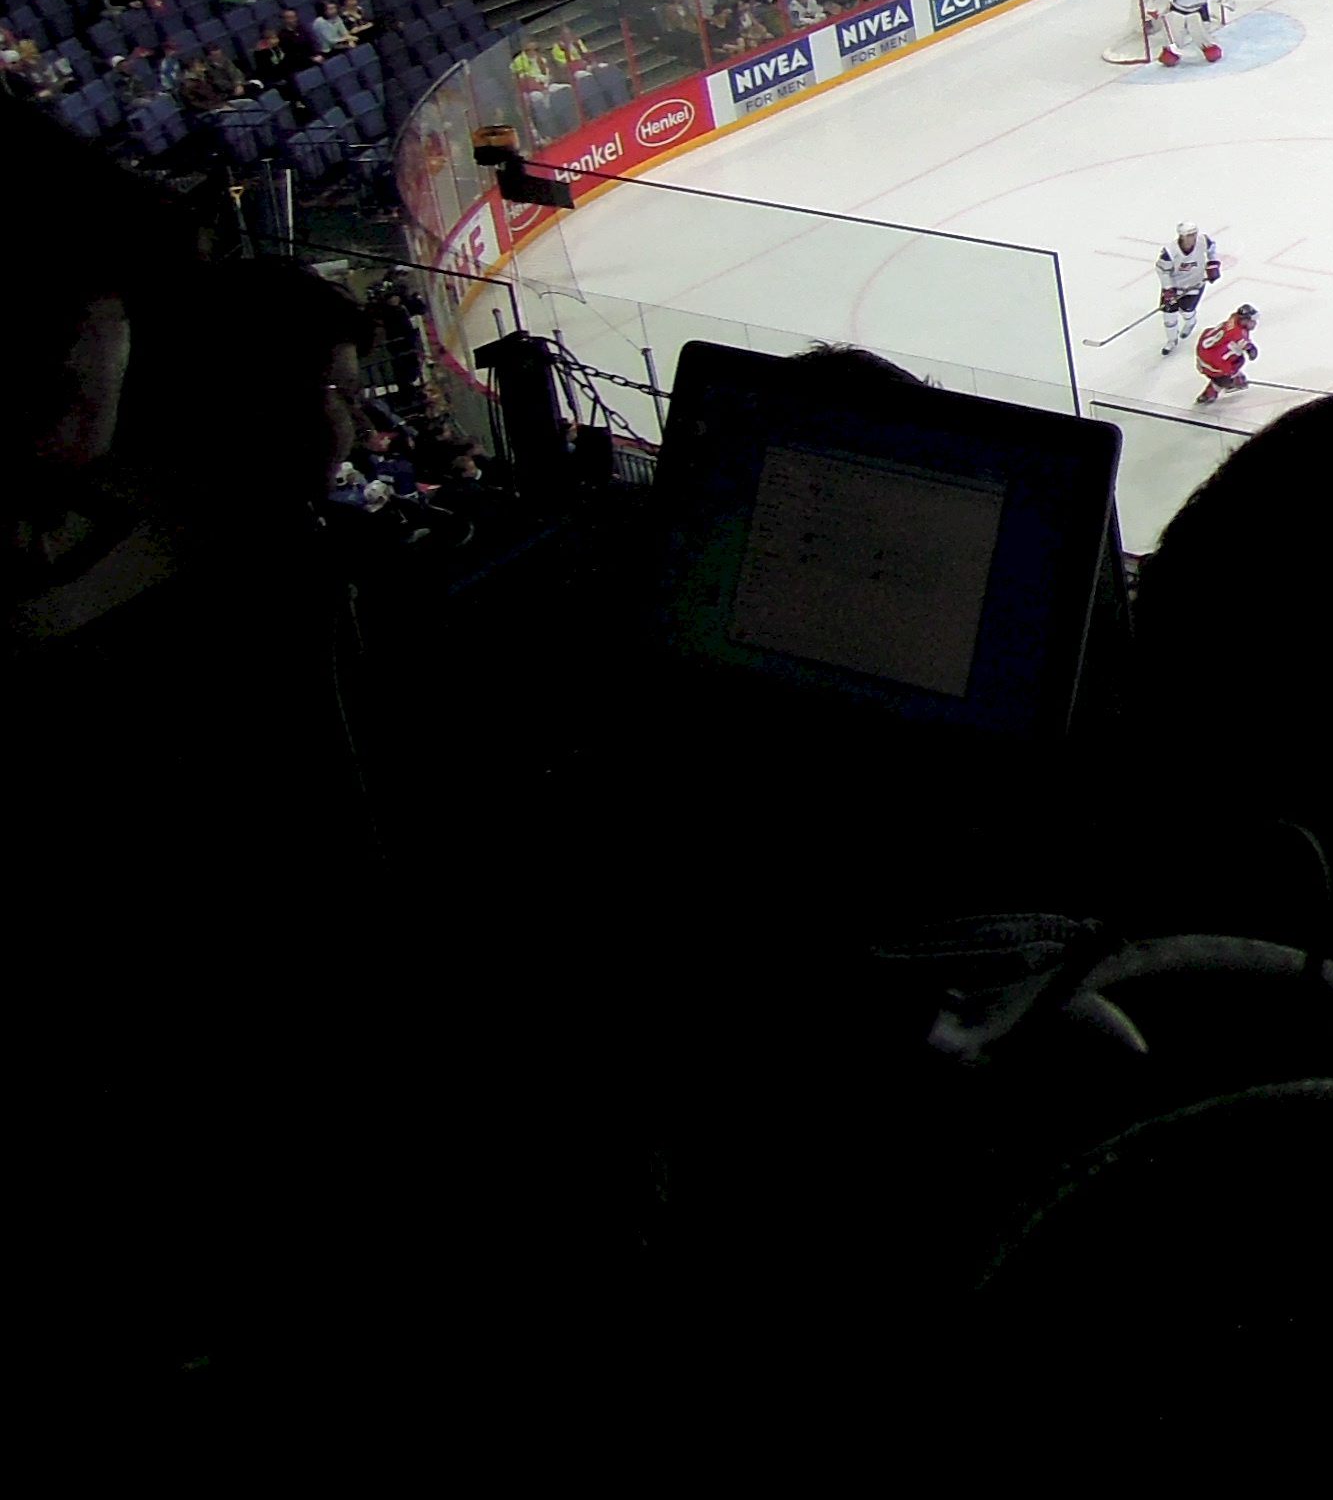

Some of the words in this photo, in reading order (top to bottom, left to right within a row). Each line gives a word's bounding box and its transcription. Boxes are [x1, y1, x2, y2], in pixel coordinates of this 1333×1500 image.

[842, 5, 910, 48] NIVEA
[851, 48, 876, 65] FOR
[880, 34, 908, 53] MEN
[735, 48, 809, 94] NIVEA
[746, 94, 772, 112] FOR
[778, 77, 807, 97] MEN
[641, 106, 690, 139] Henkel
